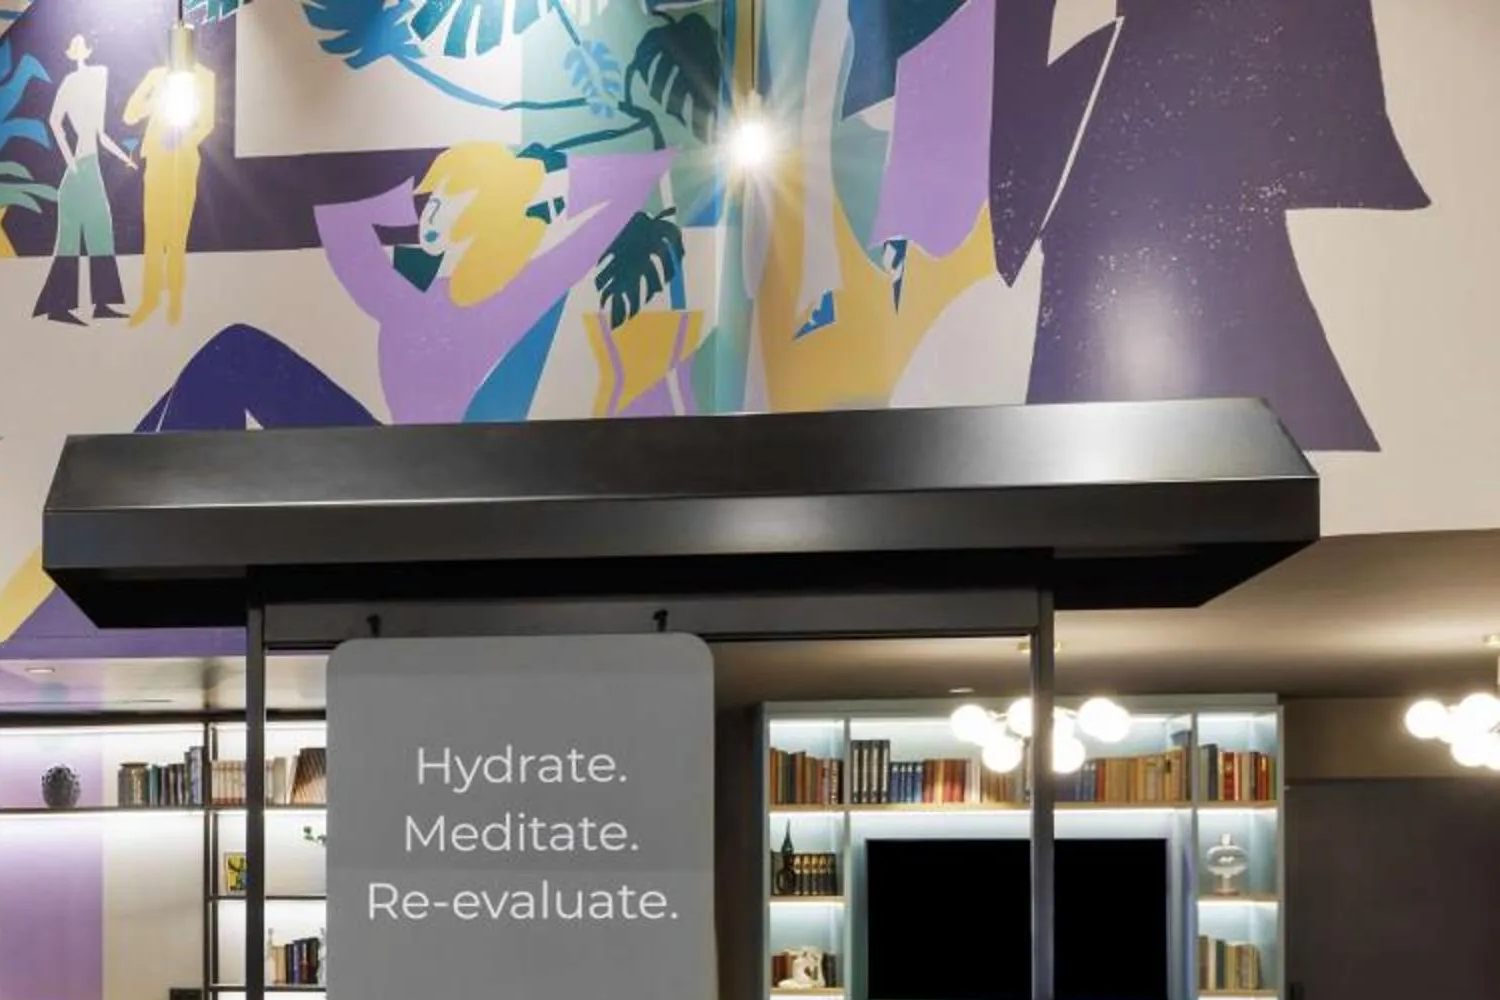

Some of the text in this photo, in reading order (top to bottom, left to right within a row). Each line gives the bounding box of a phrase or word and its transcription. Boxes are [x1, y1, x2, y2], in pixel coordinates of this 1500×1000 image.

[417, 744, 627, 794] Hydrate.
[404, 812, 639, 852] Meditate.
[367, 879, 679, 920] Re-evaluate.
